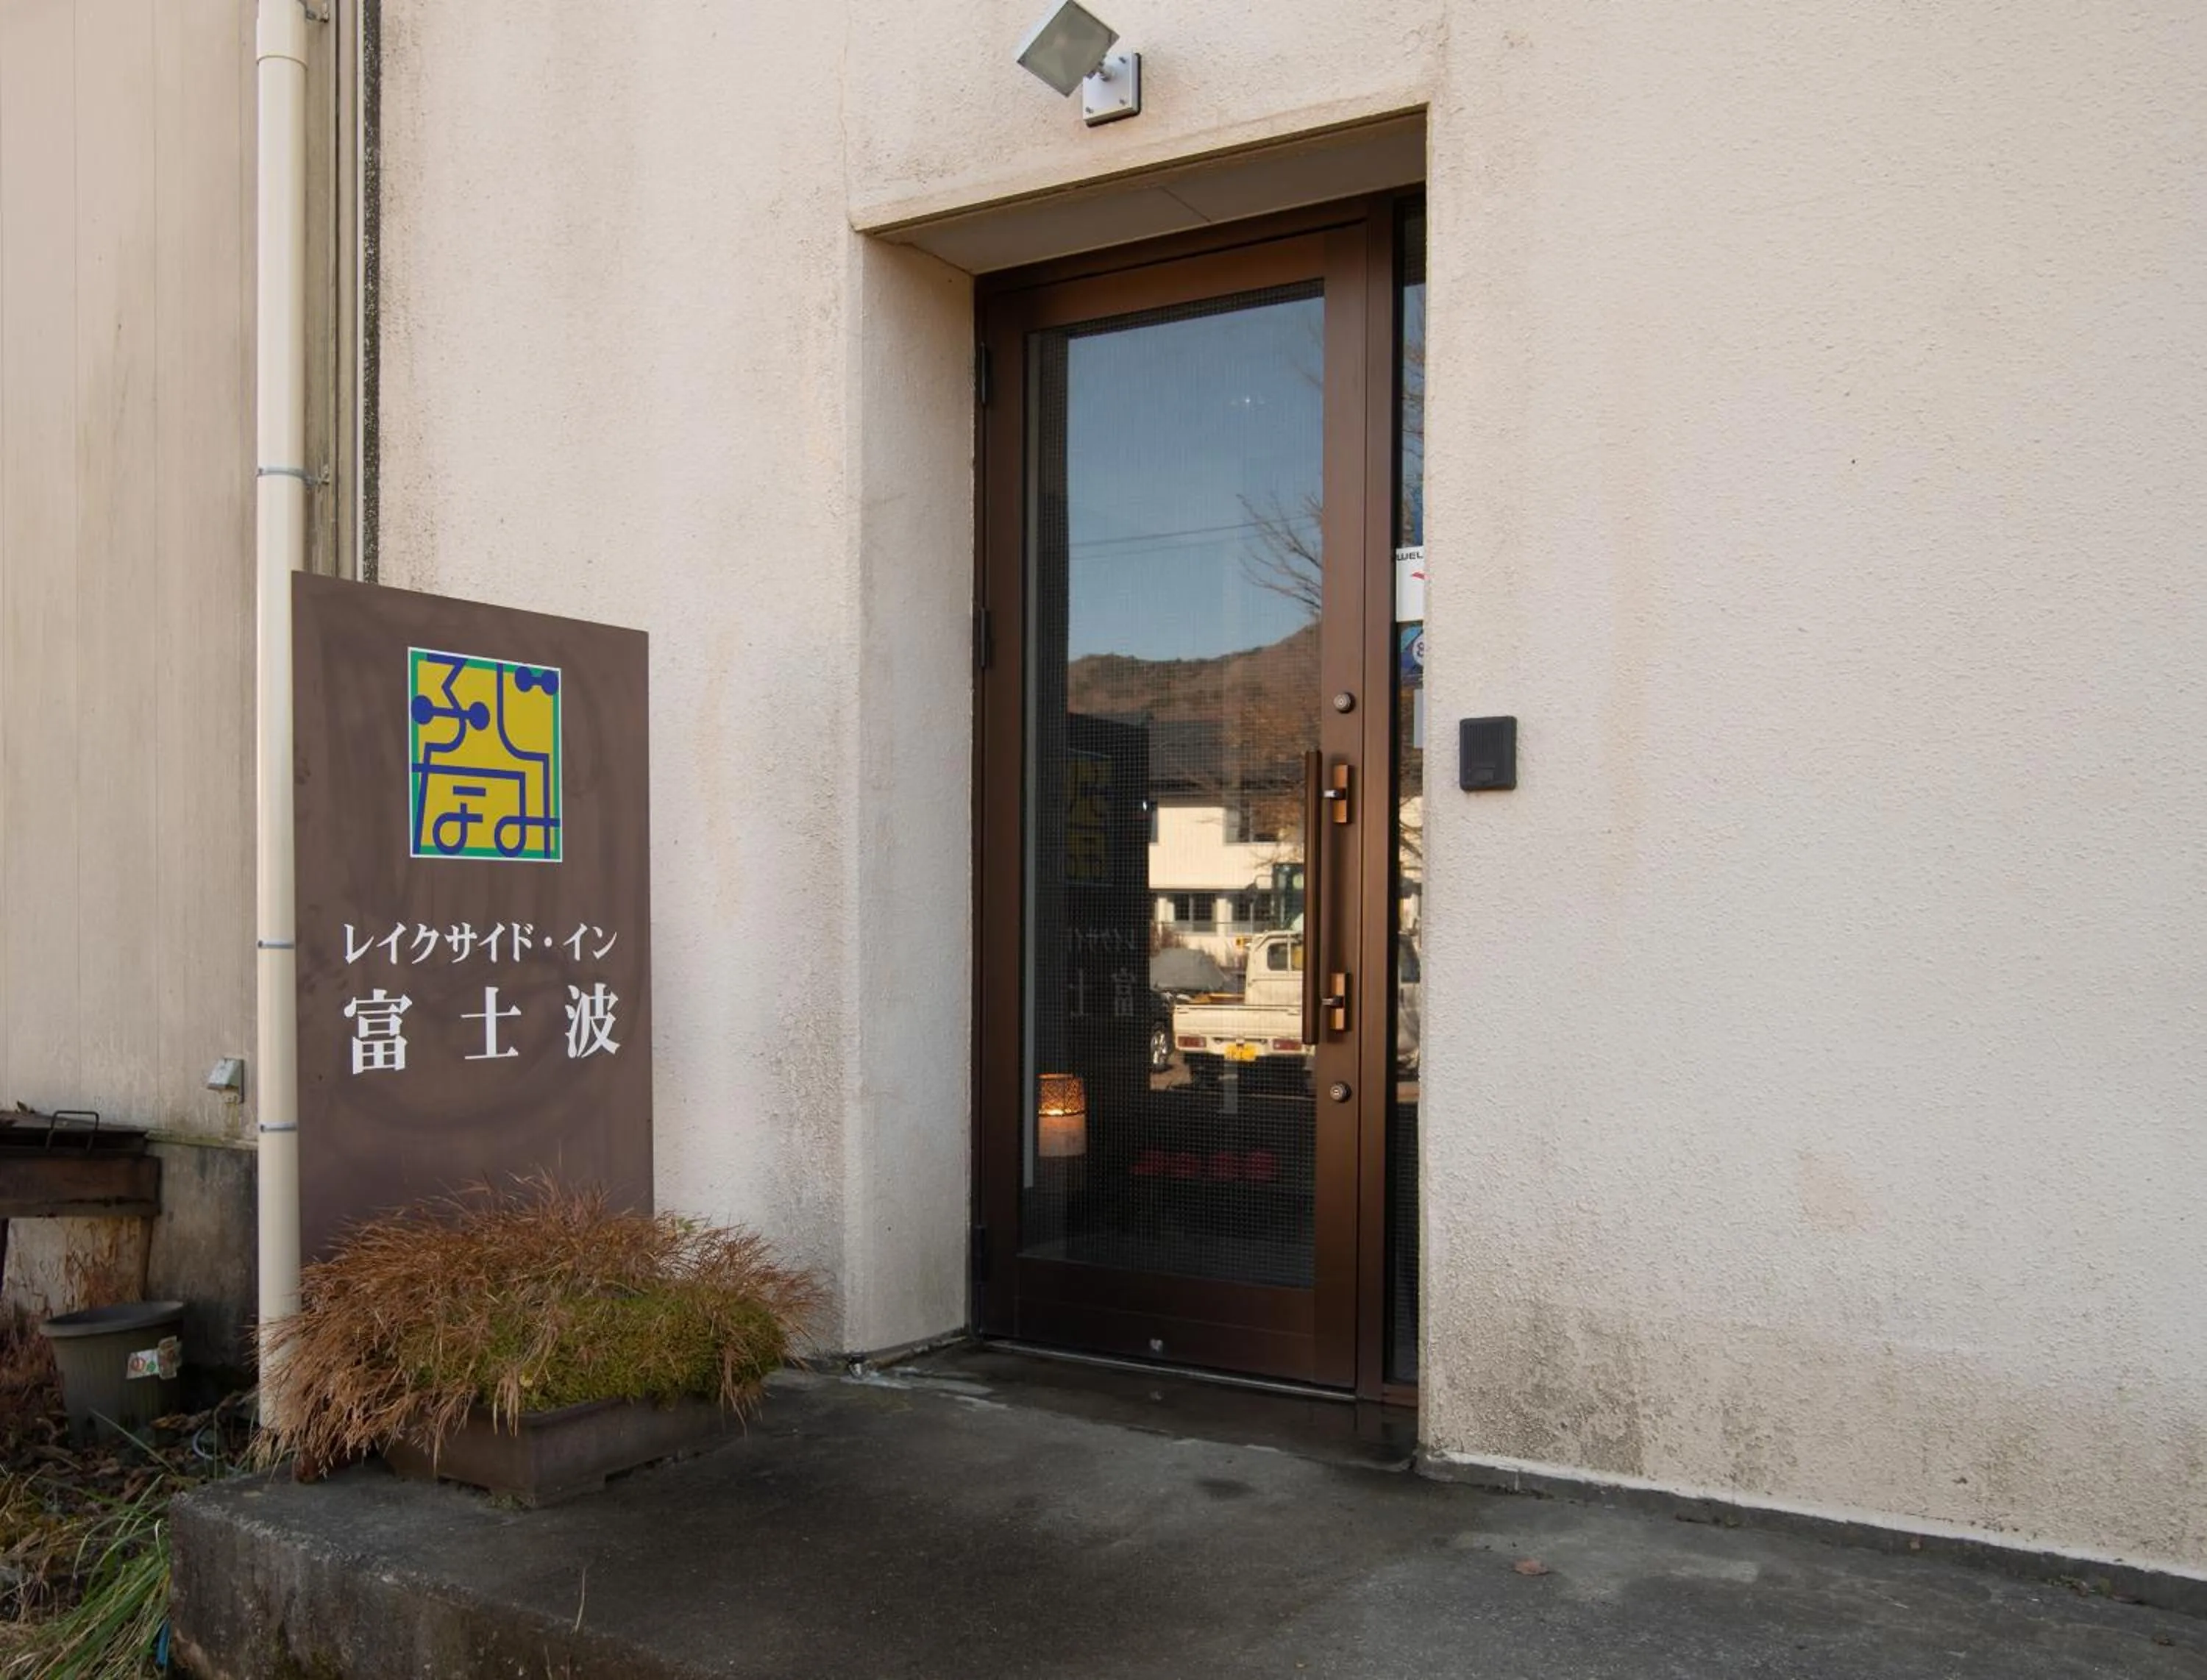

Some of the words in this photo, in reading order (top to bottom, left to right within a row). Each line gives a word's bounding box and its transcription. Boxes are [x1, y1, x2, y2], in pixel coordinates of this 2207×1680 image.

[344, 922, 617, 964] レイクサイド・イン
[344, 983, 620, 1075] 富士波
